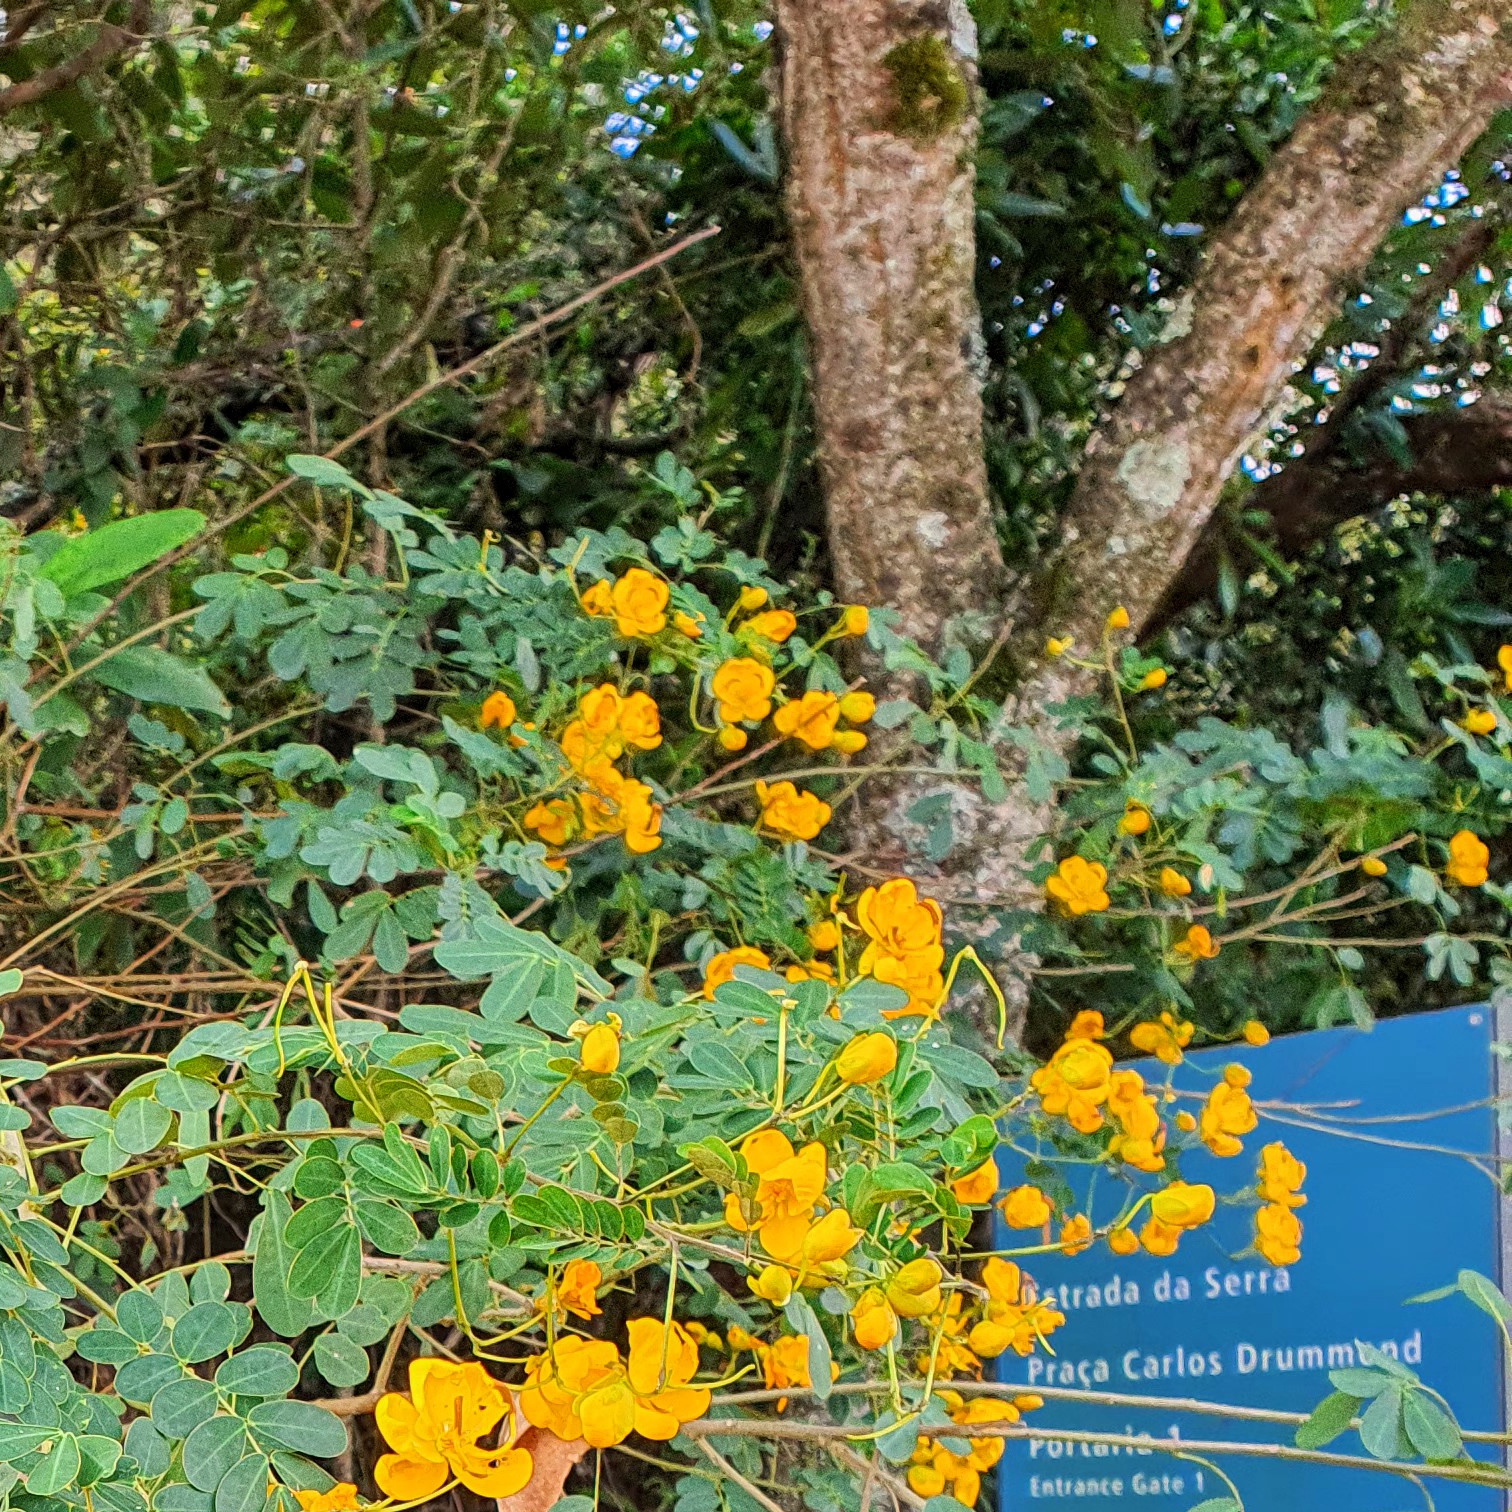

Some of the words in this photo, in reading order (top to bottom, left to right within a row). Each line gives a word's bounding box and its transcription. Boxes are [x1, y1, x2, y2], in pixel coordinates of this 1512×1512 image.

[1153, 1270, 1191, 1302] da
[1205, 1266, 1292, 1299] Serra
[1028, 1356, 1109, 1390] Praça
[1123, 1344, 1223, 1380] Carlos
[1029, 1474, 1124, 1498] Entrance
[1132, 1471, 1185, 1496] Gate
[1195, 1471, 1204, 1493] 1
